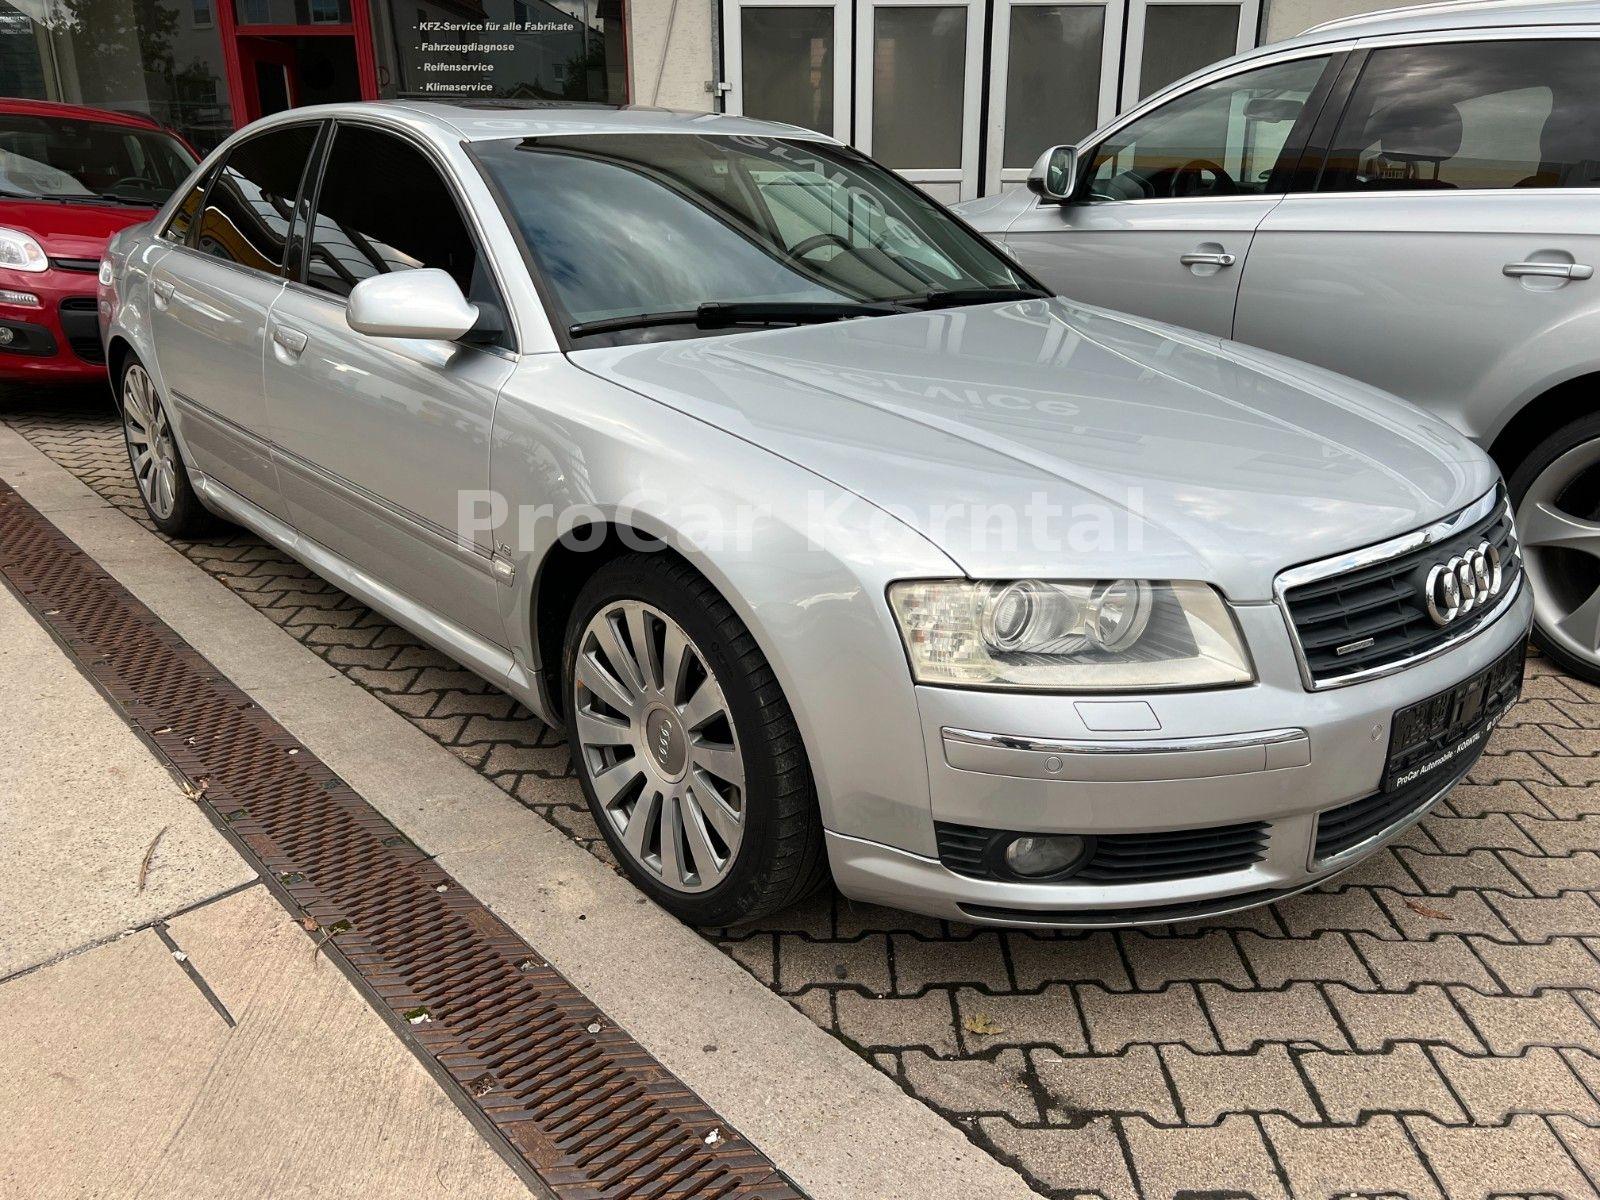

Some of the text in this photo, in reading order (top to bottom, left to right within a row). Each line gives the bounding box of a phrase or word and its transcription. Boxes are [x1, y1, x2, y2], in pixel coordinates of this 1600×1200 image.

[419, 21, 574, 31] KFZ-Service für alle Fabrikate
[421, 42, 515, 53] Fahrzeugdiagnose
[423, 62, 494, 72] Reifenservice
[425, 82, 493, 92] Klimaservice
[1396, 770, 1420, 787] ProCar
[1420, 750, 1454, 775] Automobile
